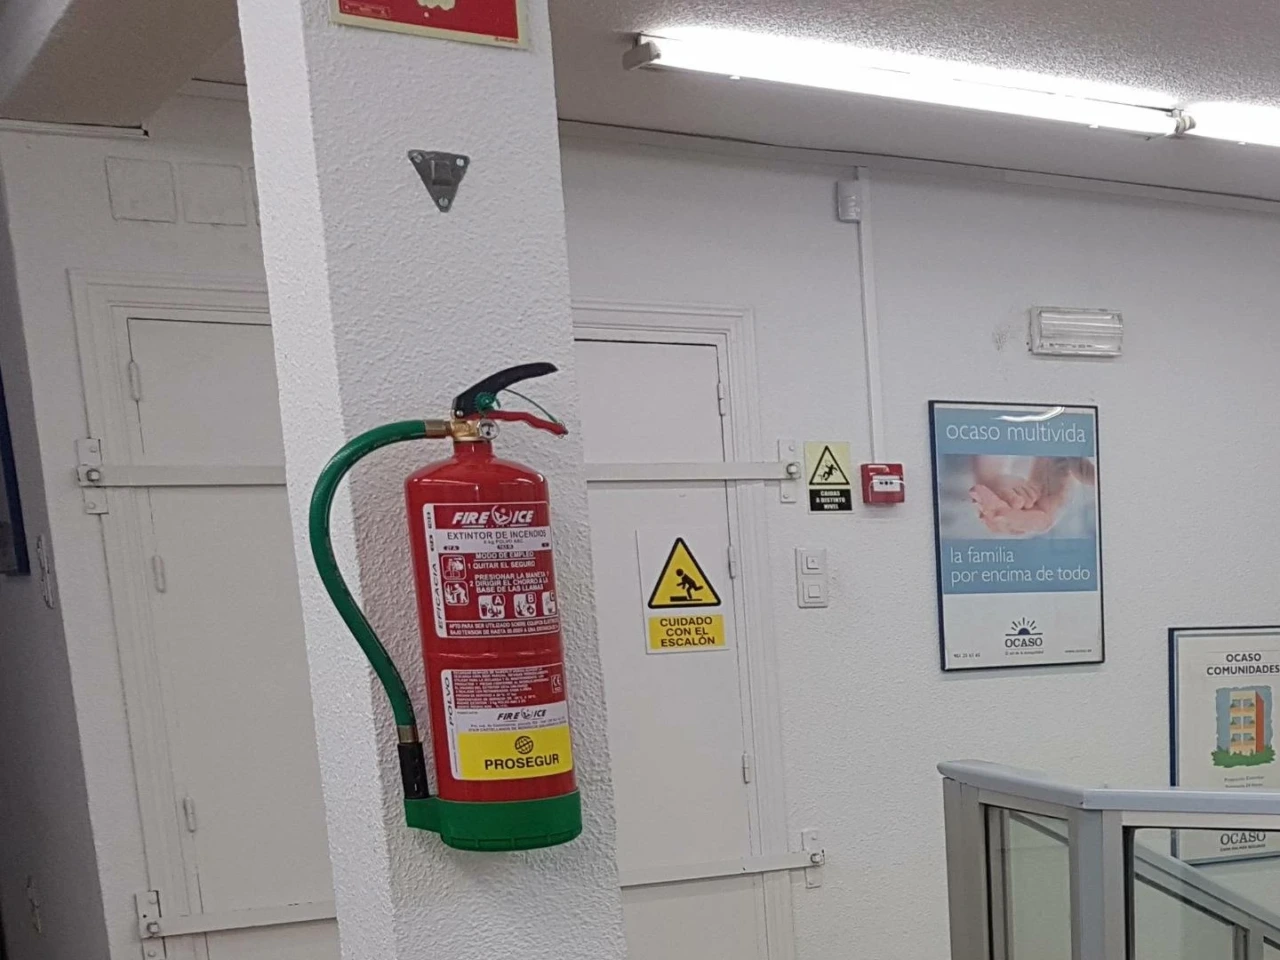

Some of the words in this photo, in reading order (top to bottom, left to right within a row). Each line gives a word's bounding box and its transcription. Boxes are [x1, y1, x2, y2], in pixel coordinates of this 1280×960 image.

[946, 424, 1000, 440] ocaso
[1007, 422, 1086, 443] multivida
[452, 511, 490, 525] FIRE
[512, 510, 534, 523] ICE
[447, 531, 493, 540] EXTINTOR
[495, 531, 508, 539] DE
[510, 529, 547, 538] INCENDIOS
[950, 547, 963, 563] la
[968, 546, 1015, 563] familia
[511, 560, 536, 568] SEGURO
[951, 570, 977, 587] por
[981, 566, 1032, 582] encima
[1035, 565, 1054, 581] de
[1058, 565, 1091, 581] todo
[508, 584, 521, 592] LAS
[522, 583, 544, 591] LLAMAS
[432, 563, 444, 629] EFICACIA
[494, 596, 502, 604] A
[527, 594, 533, 602] B
[660, 616, 713, 627] CUIDADO
[666, 627, 691, 637] CON
[695, 627, 708, 636] EL
[660, 634, 715, 647] ESCALÓN
[1004, 637, 1043, 648] OCASO
[1226, 653, 1262, 662] OCASO
[1206, 664, 1280, 675] COMUNIDADES
[444, 677, 454, 726] POLVO
[497, 711, 519, 720] FIRE
[534, 709, 546, 718] ICE
[484, 753, 560, 771] PROSEGUR
[1220, 831, 1266, 846] OCASO
